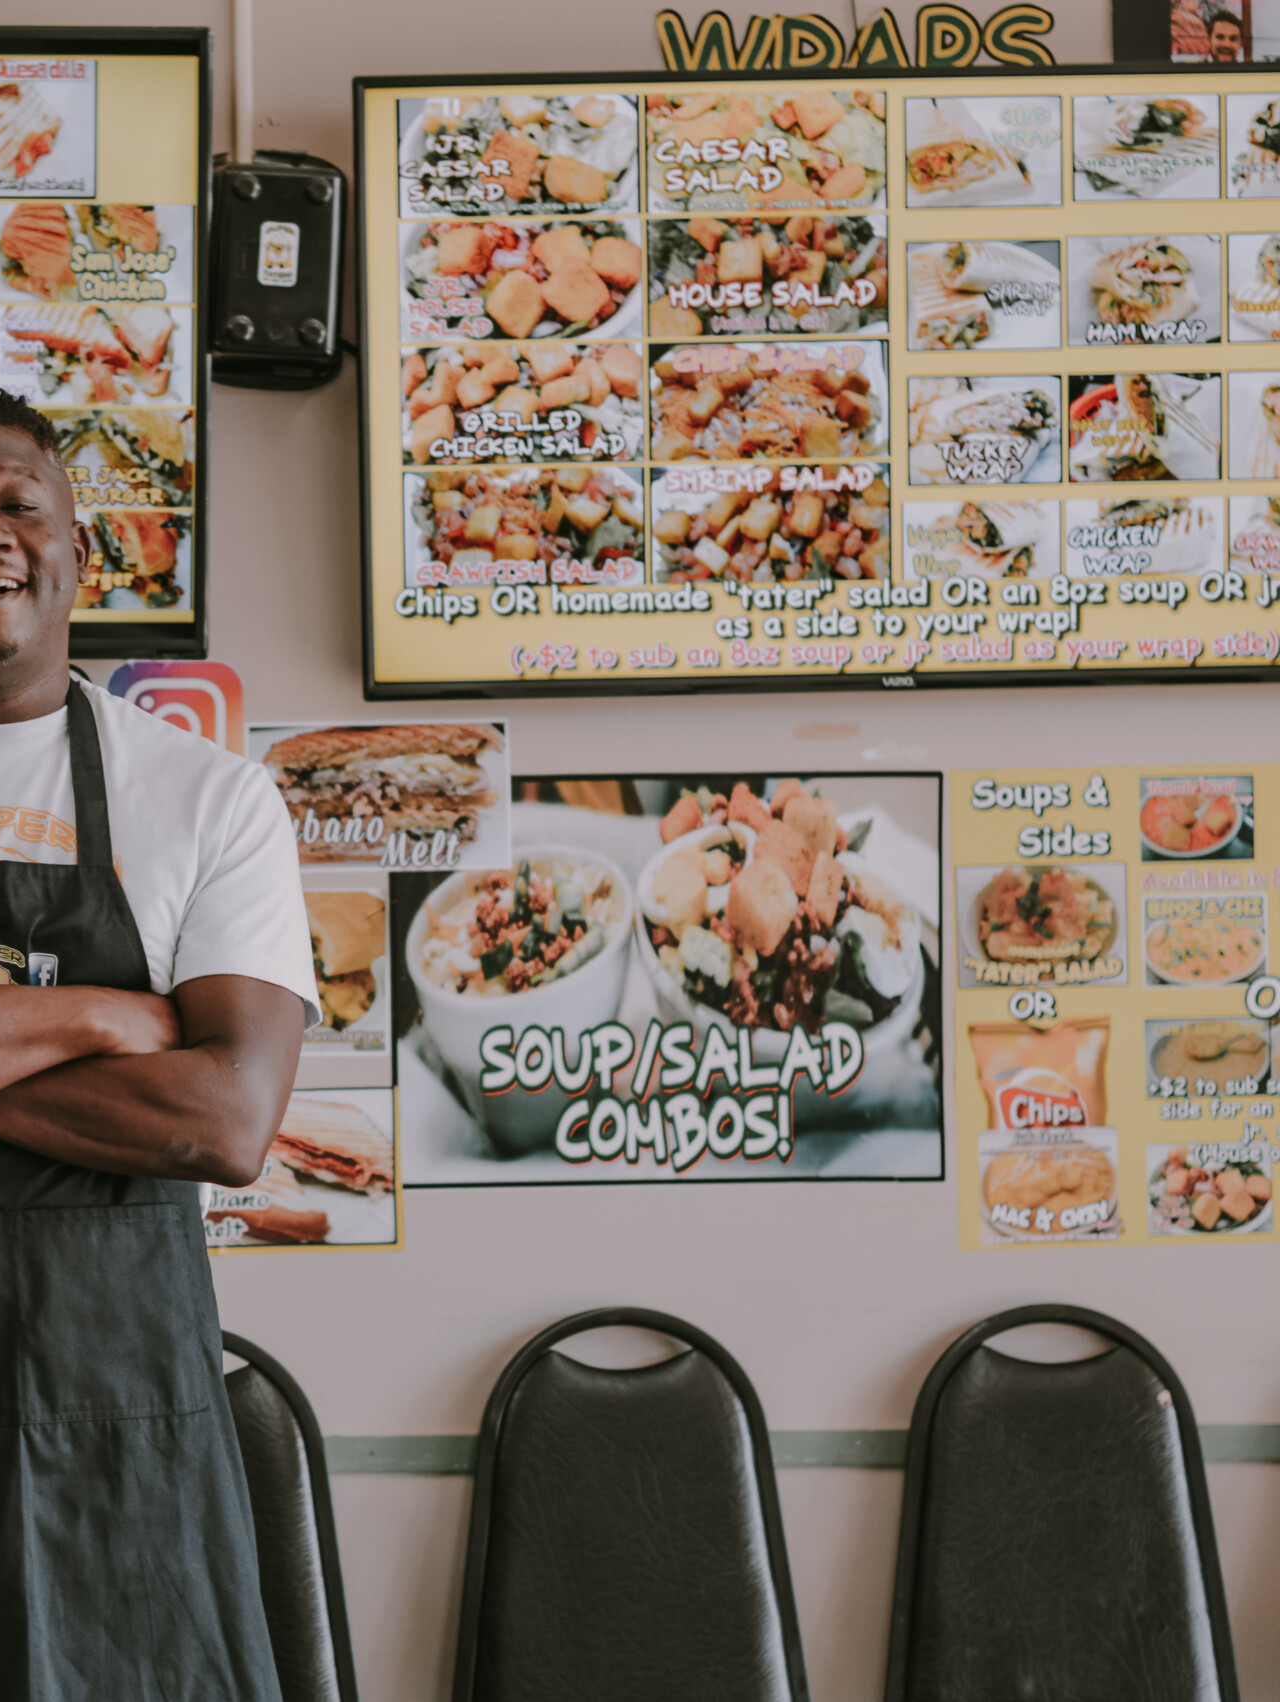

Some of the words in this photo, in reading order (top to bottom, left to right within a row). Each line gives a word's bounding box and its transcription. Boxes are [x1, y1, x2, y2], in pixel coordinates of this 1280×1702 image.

[655, 137, 792, 163] CAESAR
[399, 159, 511, 179] CAESAR
[665, 166, 783, 193] SALAD
[408, 183, 505, 203] SALAD
[70, 244, 114, 272] San
[79, 272, 167, 300] Chicken
[668, 281, 763, 308] HOUSE
[771, 279, 877, 308] SALAD
[408, 299, 484, 317] HOUSE
[409, 318, 493, 338] SALAD
[1086, 321, 1136, 343] HAM
[1141, 320, 1207, 343] WRAP
[755, 345, 865, 372] SALAD
[462, 409, 582, 433] GRILLED
[429, 436, 534, 459] CHICKEN
[540, 434, 626, 457] SALAD
[935, 439, 1031, 461] TURKEY
[97, 466, 150, 484] JACK
[665, 466, 773, 493] SHRIMP
[780, 465, 874, 492] SALAD
[947, 458, 1023, 483] WRAP
[1068, 525, 1161, 549] CHICKEN
[416, 559, 547, 585] CRAWFISH
[551, 556, 637, 584] SALAD
[1083, 553, 1152, 576] WRAP
[395, 587, 478, 624] Chips
[490, 584, 538, 615] OR
[551, 581, 713, 614] homemade
[722, 579, 833, 611] "tater"
[849, 578, 929, 609] salad
[942, 576, 989, 607] OR
[1001, 581, 1040, 607] an
[1049, 574, 1108, 605] 8oz
[1119, 577, 1187, 609] soup
[1198, 571, 1246, 602] OR
[715, 615, 752, 640] as
[763, 616, 784, 638] a
[795, 607, 858, 637] side
[871, 609, 905, 635] to
[919, 610, 985, 638] your
[998, 603, 1079, 637] wrap!
[588, 643, 619, 668] to
[629, 640, 678, 668] sub
[686, 645, 720, 667] an
[729, 637, 780, 666] 8oz
[790, 641, 852, 672] soup
[860, 641, 893, 664] or
[901, 638, 929, 671] jr
[940, 633, 1014, 662] salad
[1023, 638, 1056, 661] as
[1065, 635, 1126, 669] your
[1135, 633, 1203, 667] wrap
[1212, 628, 1279, 664] side)
[971, 778, 1072, 818] Soups
[1083, 773, 1110, 807] &
[379, 831, 462, 868] Melt
[1018, 822, 1112, 858] Sides
[1145, 898, 1203, 919] BROC
[1054, 957, 1123, 985] SALAD
[1009, 990, 1057, 1019] OR
[480, 1018, 865, 1097] SOUP/SALAD
[1194, 1077, 1217, 1096] to
[1225, 1074, 1259, 1095] sub
[1009, 1094, 1083, 1129] Chips
[1160, 1096, 1202, 1120] side
[1209, 1096, 1243, 1120] for
[1249, 1101, 1274, 1118] an
[555, 1093, 794, 1173] COMBOS!
